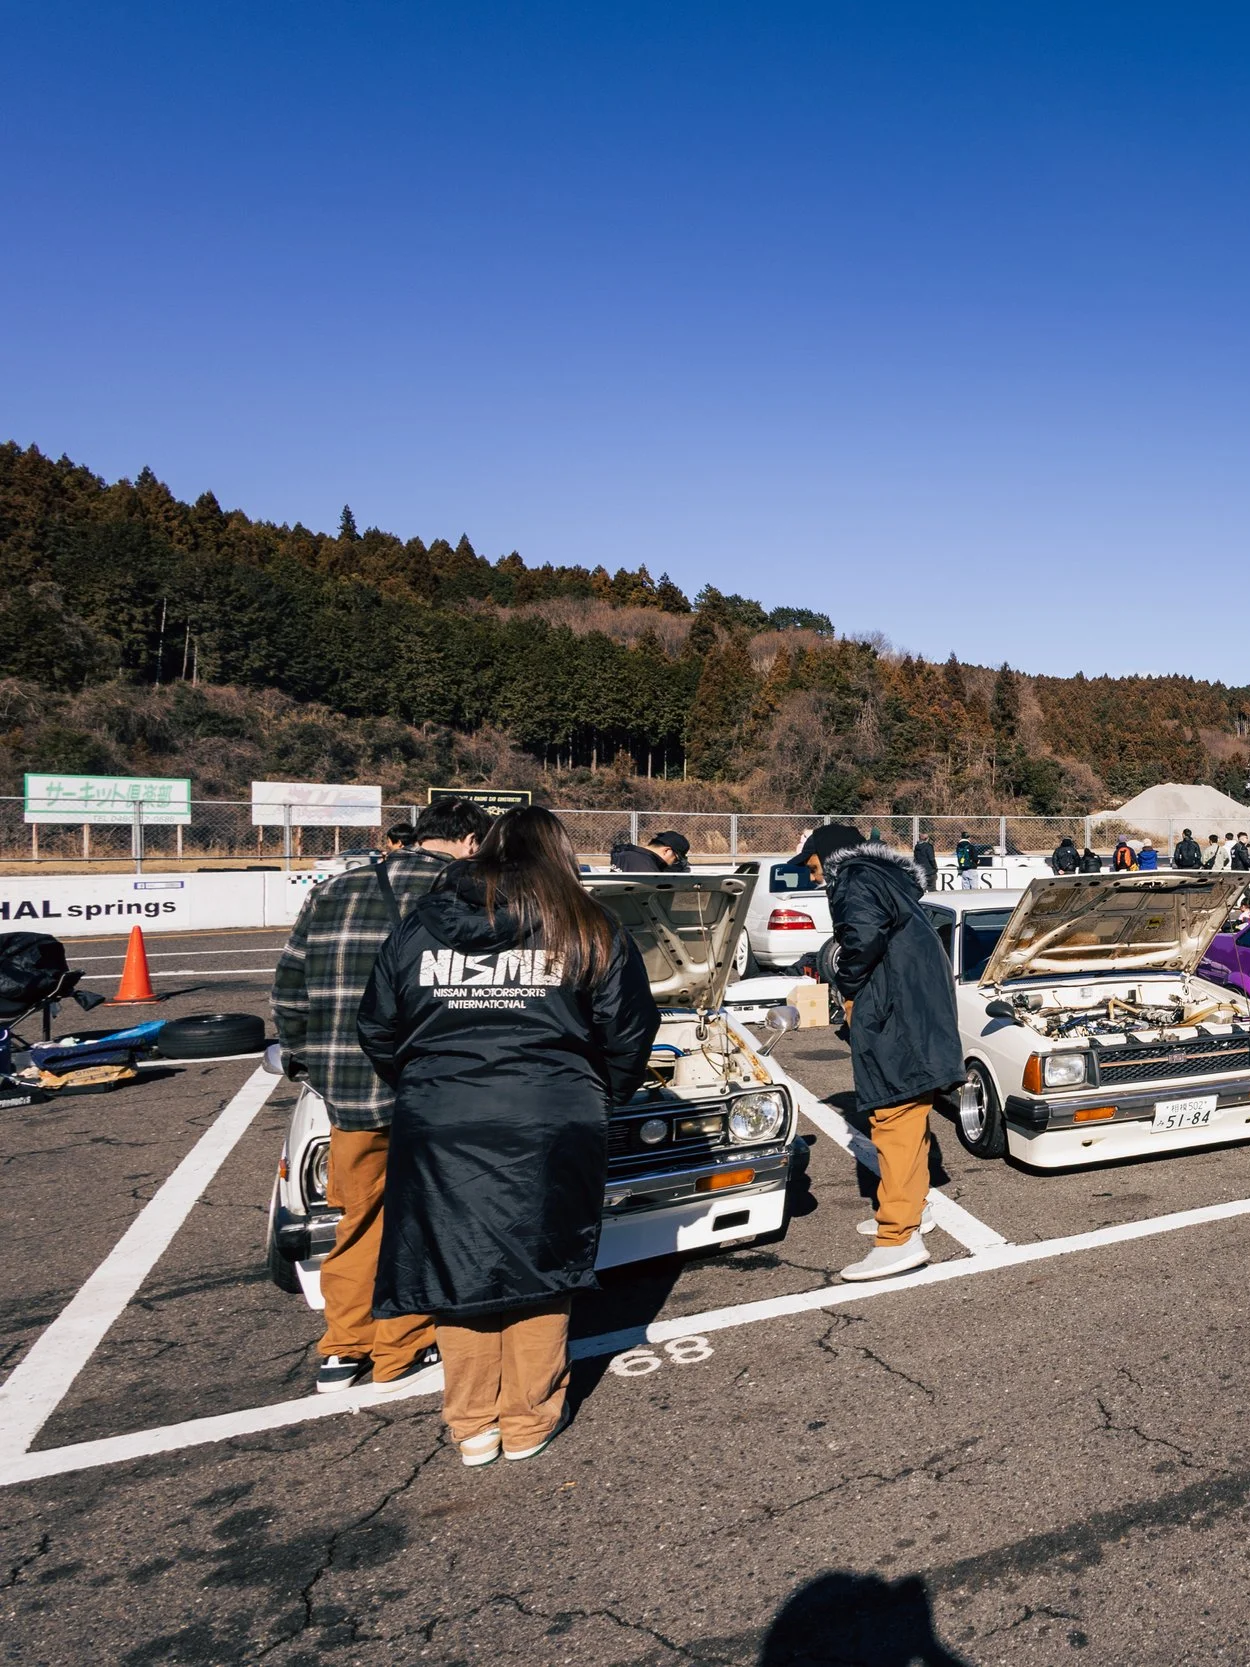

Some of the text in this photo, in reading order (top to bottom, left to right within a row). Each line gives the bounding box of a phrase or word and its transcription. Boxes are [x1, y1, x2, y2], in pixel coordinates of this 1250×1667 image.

[67, 900, 176, 920] springs
[419, 949, 566, 987] NISMO
[433, 988, 546, 998] NISSAN MOTORSPORTS
[448, 1000, 526, 1009] INTERNATIONAL
[1166, 1110, 1211, 1129] 51-84
